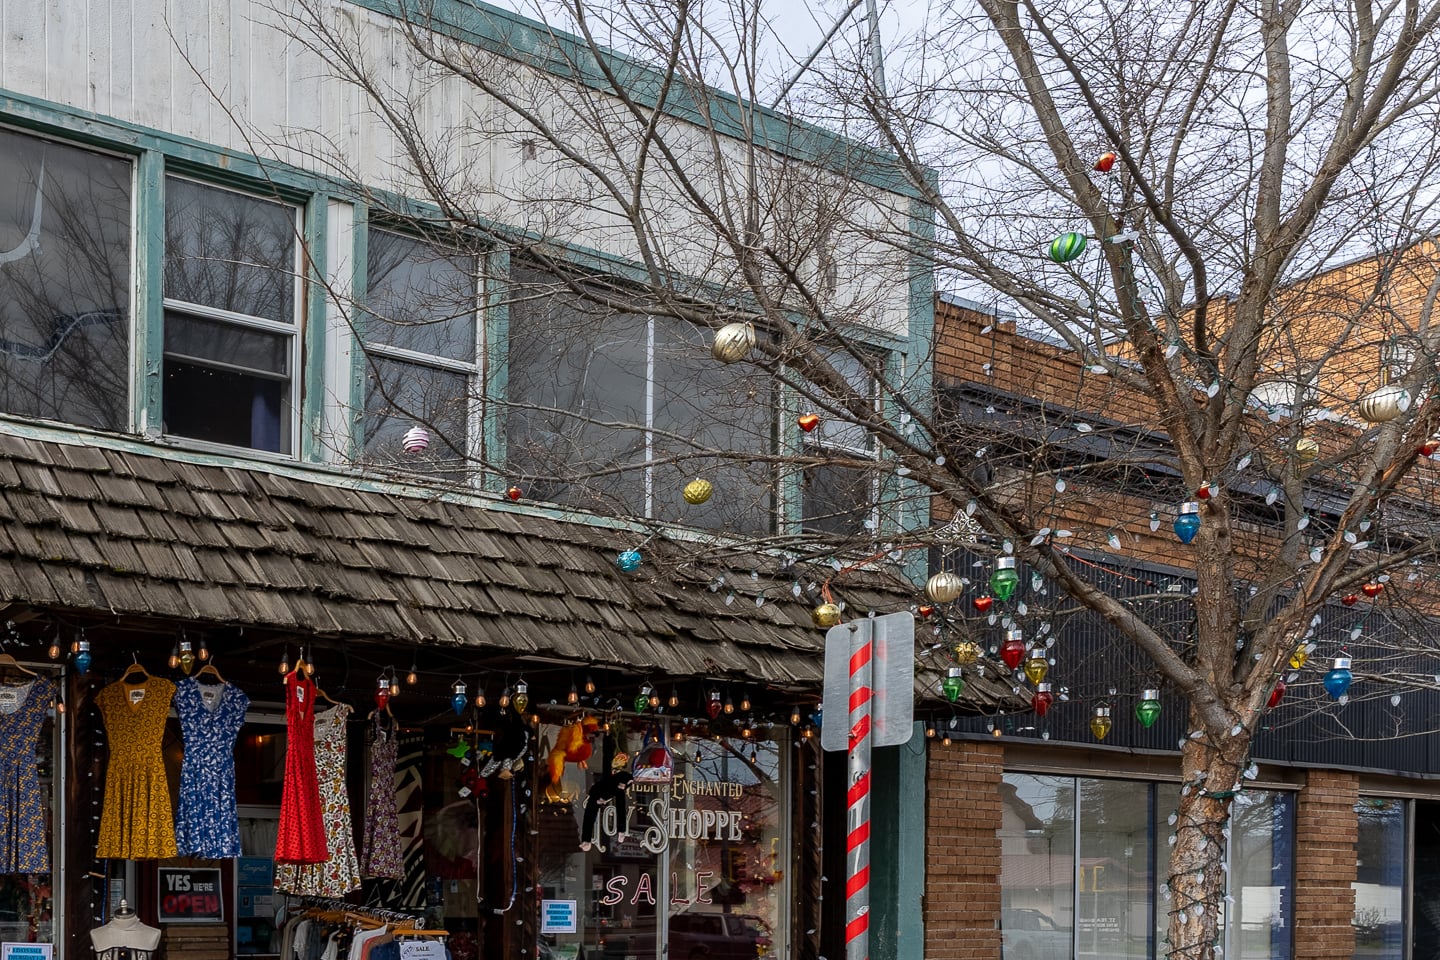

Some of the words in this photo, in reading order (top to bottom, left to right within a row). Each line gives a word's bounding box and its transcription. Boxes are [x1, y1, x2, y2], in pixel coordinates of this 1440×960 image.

[671, 774, 743, 799] ENCHANTED
[640, 798, 743, 854] SHOPPE
[166, 874, 191, 891] YES
[193, 882, 214, 892] WE'RE
[603, 871, 714, 906] SALE
[162, 895, 219, 913] OPEN
